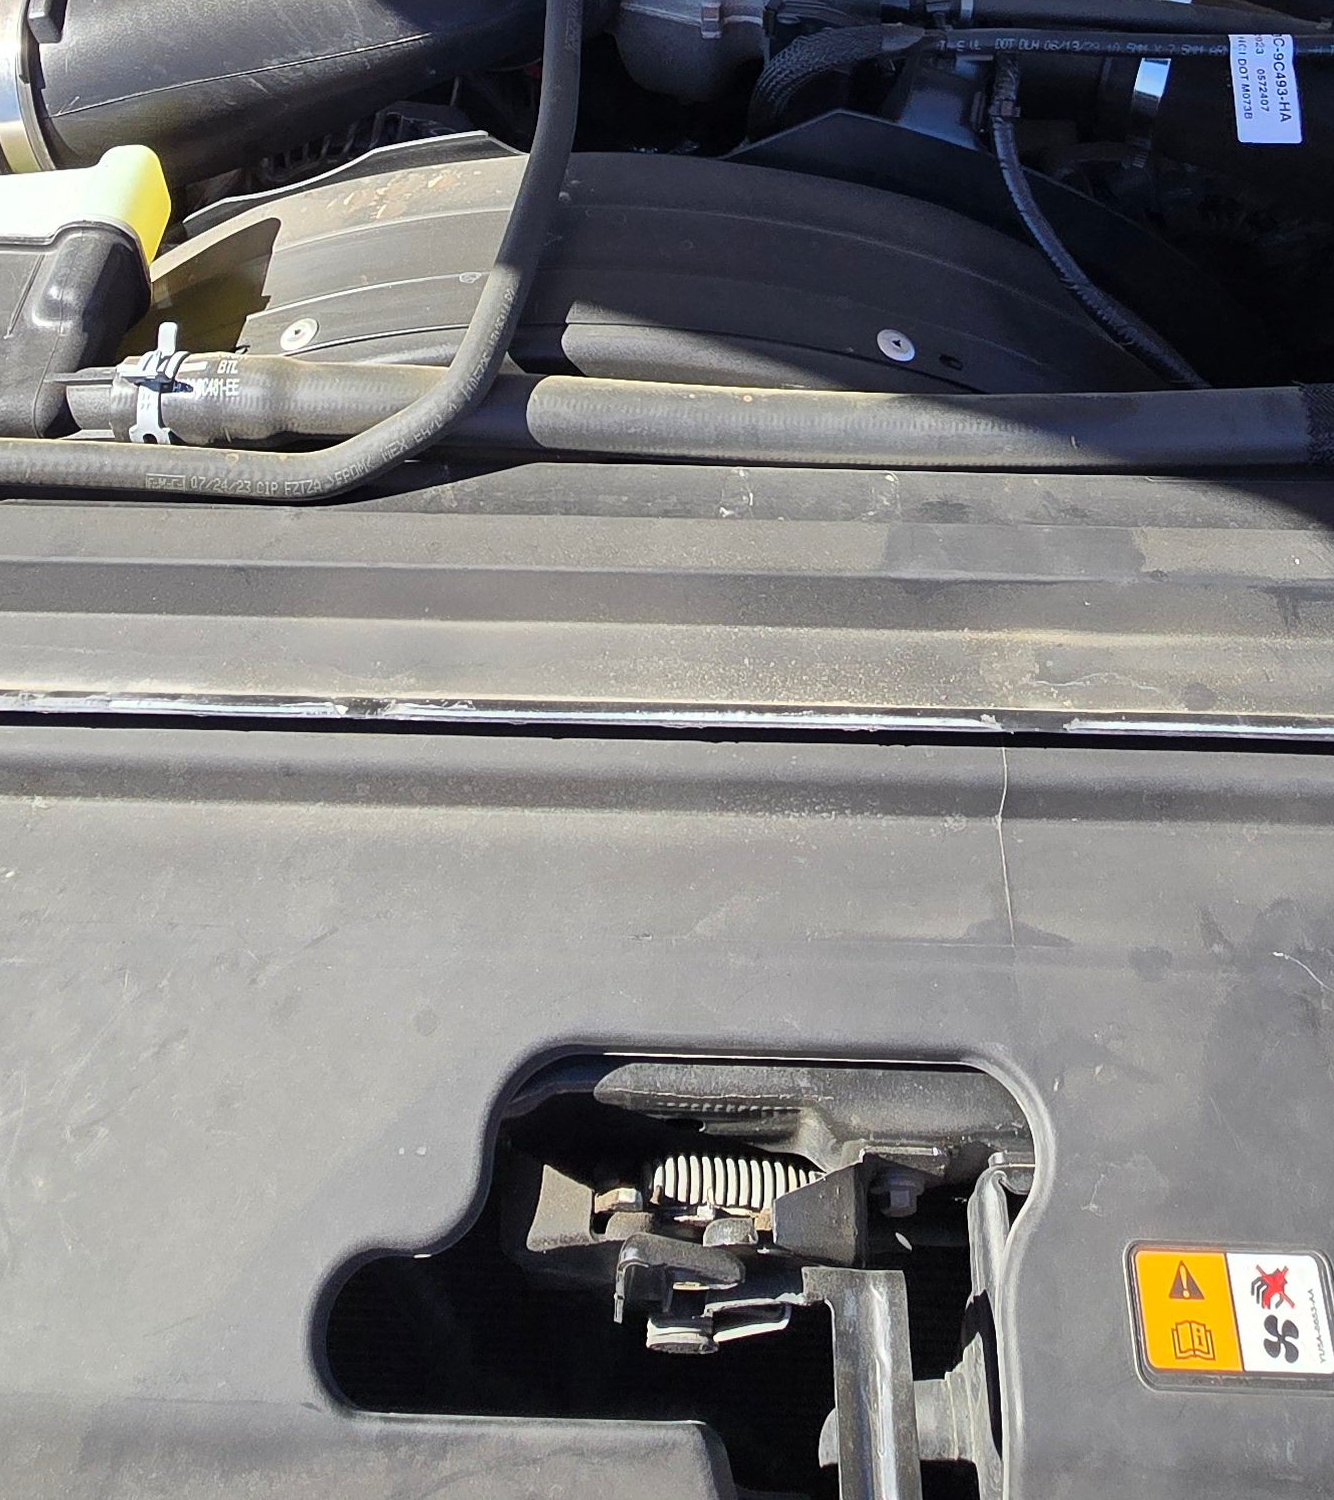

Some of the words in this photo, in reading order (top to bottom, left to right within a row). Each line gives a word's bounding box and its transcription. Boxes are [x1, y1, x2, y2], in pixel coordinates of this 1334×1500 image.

[1237, 58, 1249, 81] DOT
[1272, 34, 1293, 123] C-9C493-HA
[1240, 83, 1254, 120] M073B
[1256, 67, 1271, 113] 0572407
[379, 440, 409, 463] MEX
